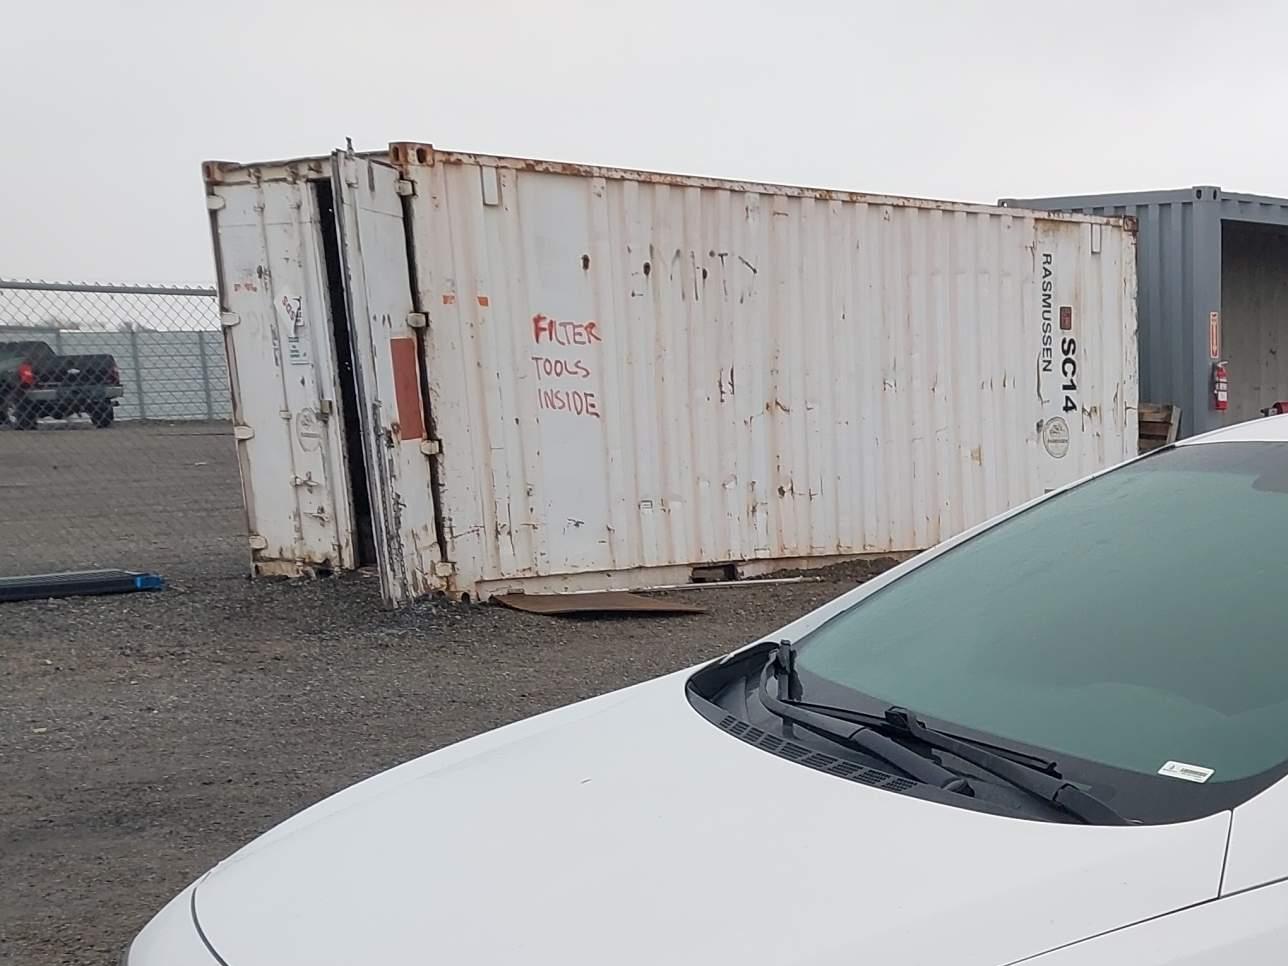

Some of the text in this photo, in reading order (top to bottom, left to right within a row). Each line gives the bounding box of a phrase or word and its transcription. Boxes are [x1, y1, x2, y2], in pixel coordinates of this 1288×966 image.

[1042, 253, 1053, 372] RASMUSSEN
[532, 314, 602, 345] FILTER
[531, 356, 590, 380] TOOLS
[1060, 336, 1078, 414] SC14
[537, 388, 600, 418] INSIDE
